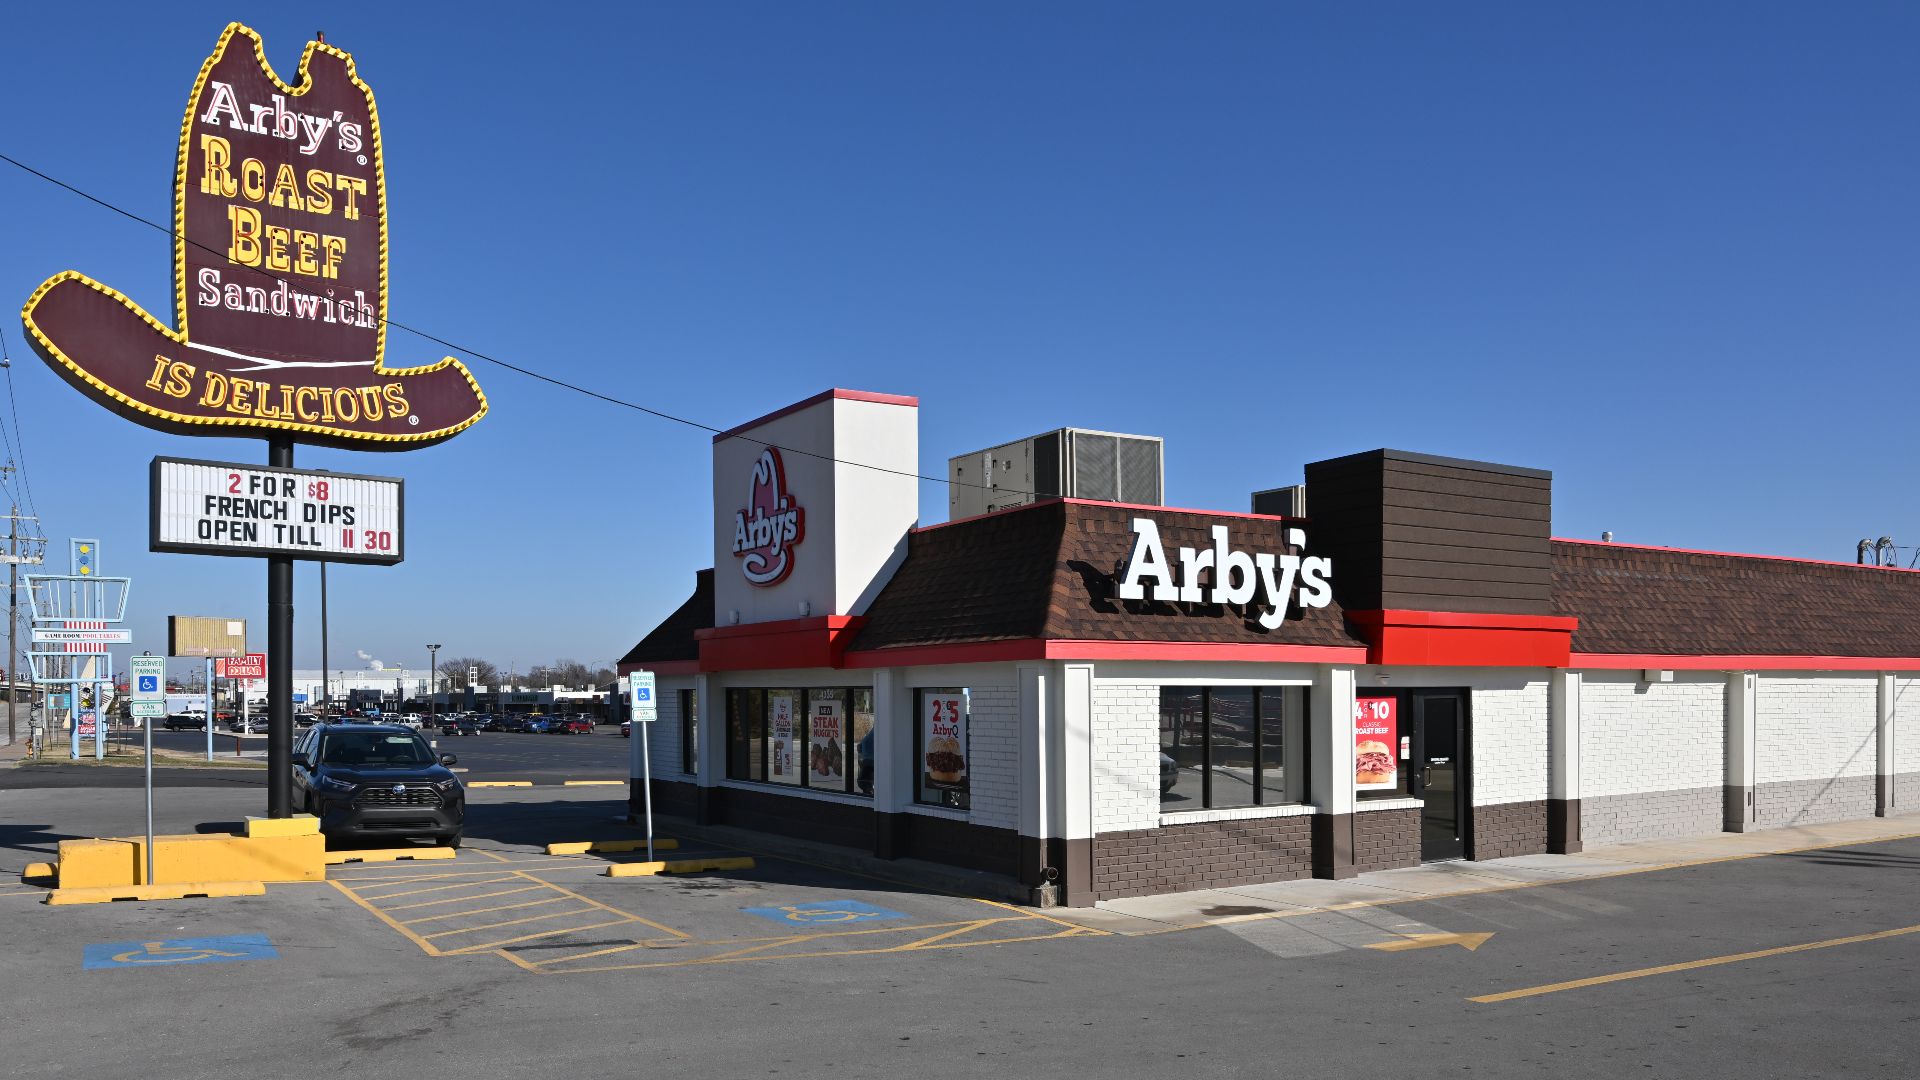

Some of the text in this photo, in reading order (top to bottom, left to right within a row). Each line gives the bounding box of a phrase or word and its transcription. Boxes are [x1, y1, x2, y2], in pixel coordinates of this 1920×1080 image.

[201, 81, 362, 155] Arby's
[201, 134, 367, 219] ROAST
[228, 204, 347, 279] BEEF
[198, 267, 377, 329] Sandwich
[145, 354, 410, 423] IS DELICIOUS
[205, 494, 355, 526] FRENCH DIPS
[228, 473, 329, 500] 2 FOR $8
[198, 519, 257, 542] OPEN
[274, 524, 322, 546] TILL
[364, 530, 391, 550] 30
[733, 498, 798, 556] Arby's
[1119, 517, 1332, 630] Arby's
[228, 656, 263, 665] FAMILY
[228, 666, 262, 675] DOLLAR
[813, 716, 838, 728] STEAK
